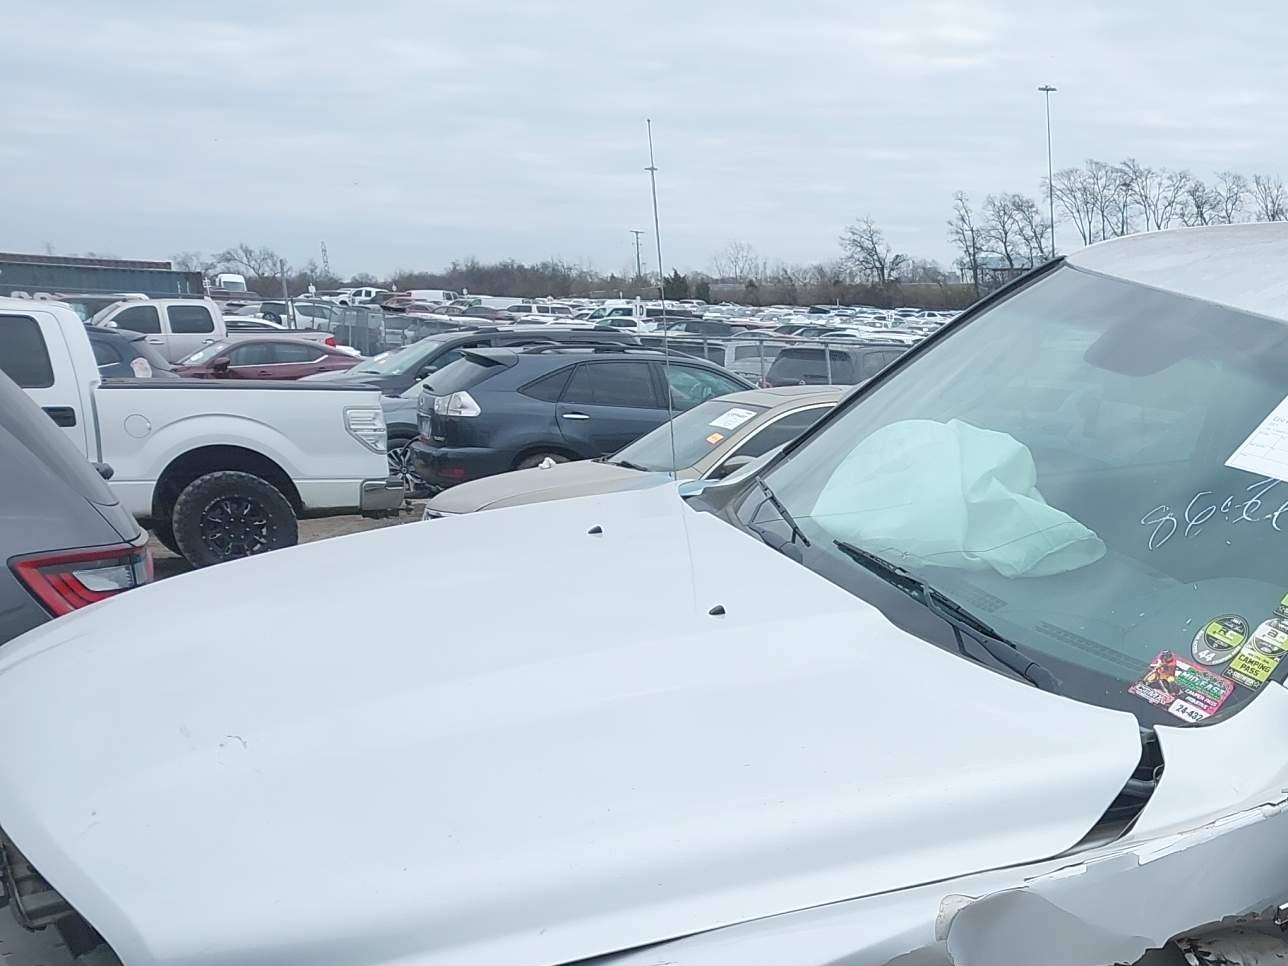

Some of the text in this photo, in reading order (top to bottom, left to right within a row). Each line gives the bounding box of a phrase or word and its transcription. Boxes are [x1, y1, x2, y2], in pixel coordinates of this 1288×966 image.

[1198, 650, 1216, 662] 44
[1238, 654, 1272, 673] CAMPING
[1239, 664, 1261, 677] PASS
